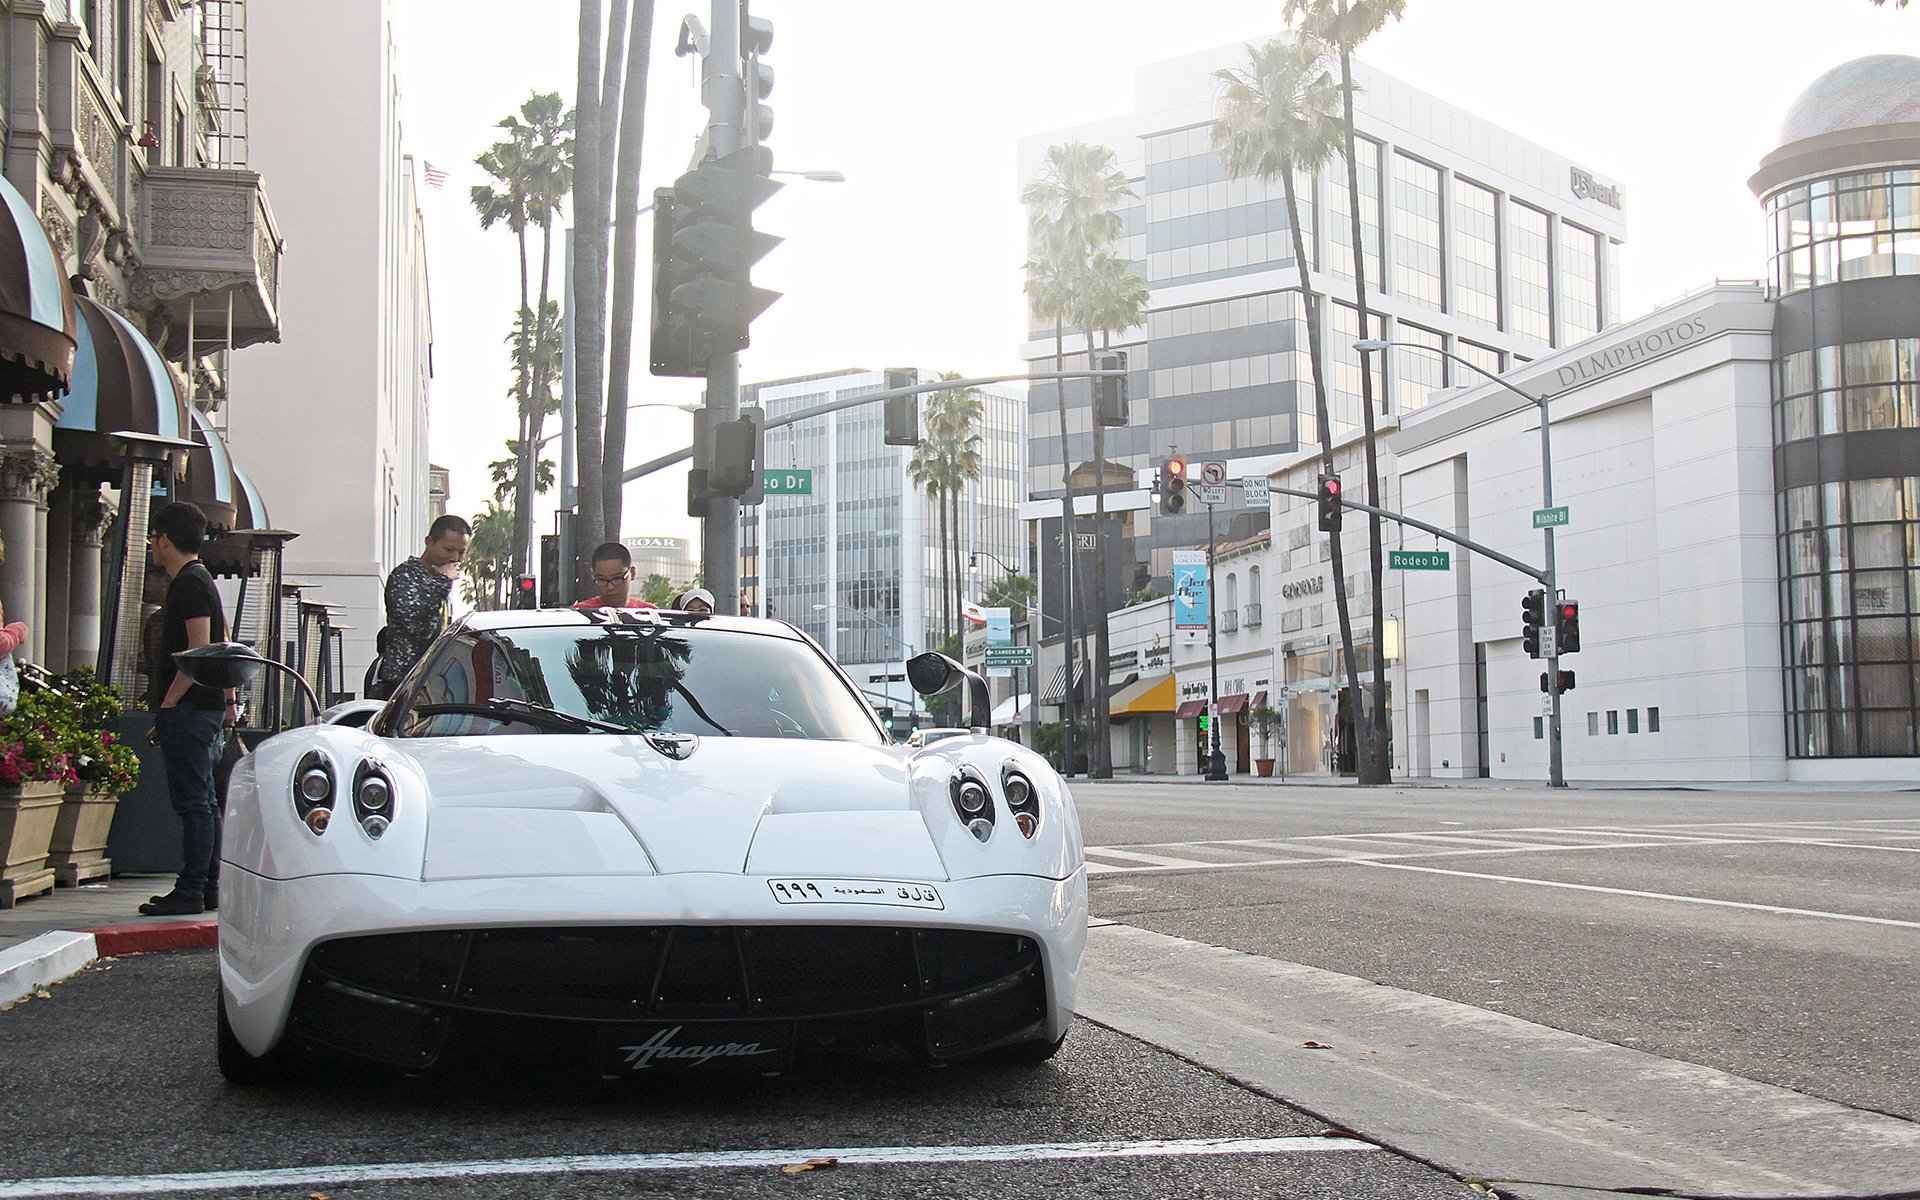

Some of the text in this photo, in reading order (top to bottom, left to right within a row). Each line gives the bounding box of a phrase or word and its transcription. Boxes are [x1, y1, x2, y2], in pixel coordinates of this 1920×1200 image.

[786, 475, 805, 489] Dr
[1244, 480, 1253, 488] DO
[1245, 490, 1268, 498] BLOCK
[627, 537, 675, 547] ROAR
[1394, 555, 1445, 566] Rodeo Dr
[1543, 628, 1552, 636] NO
[618, 1025, 777, 1069] Huayra
